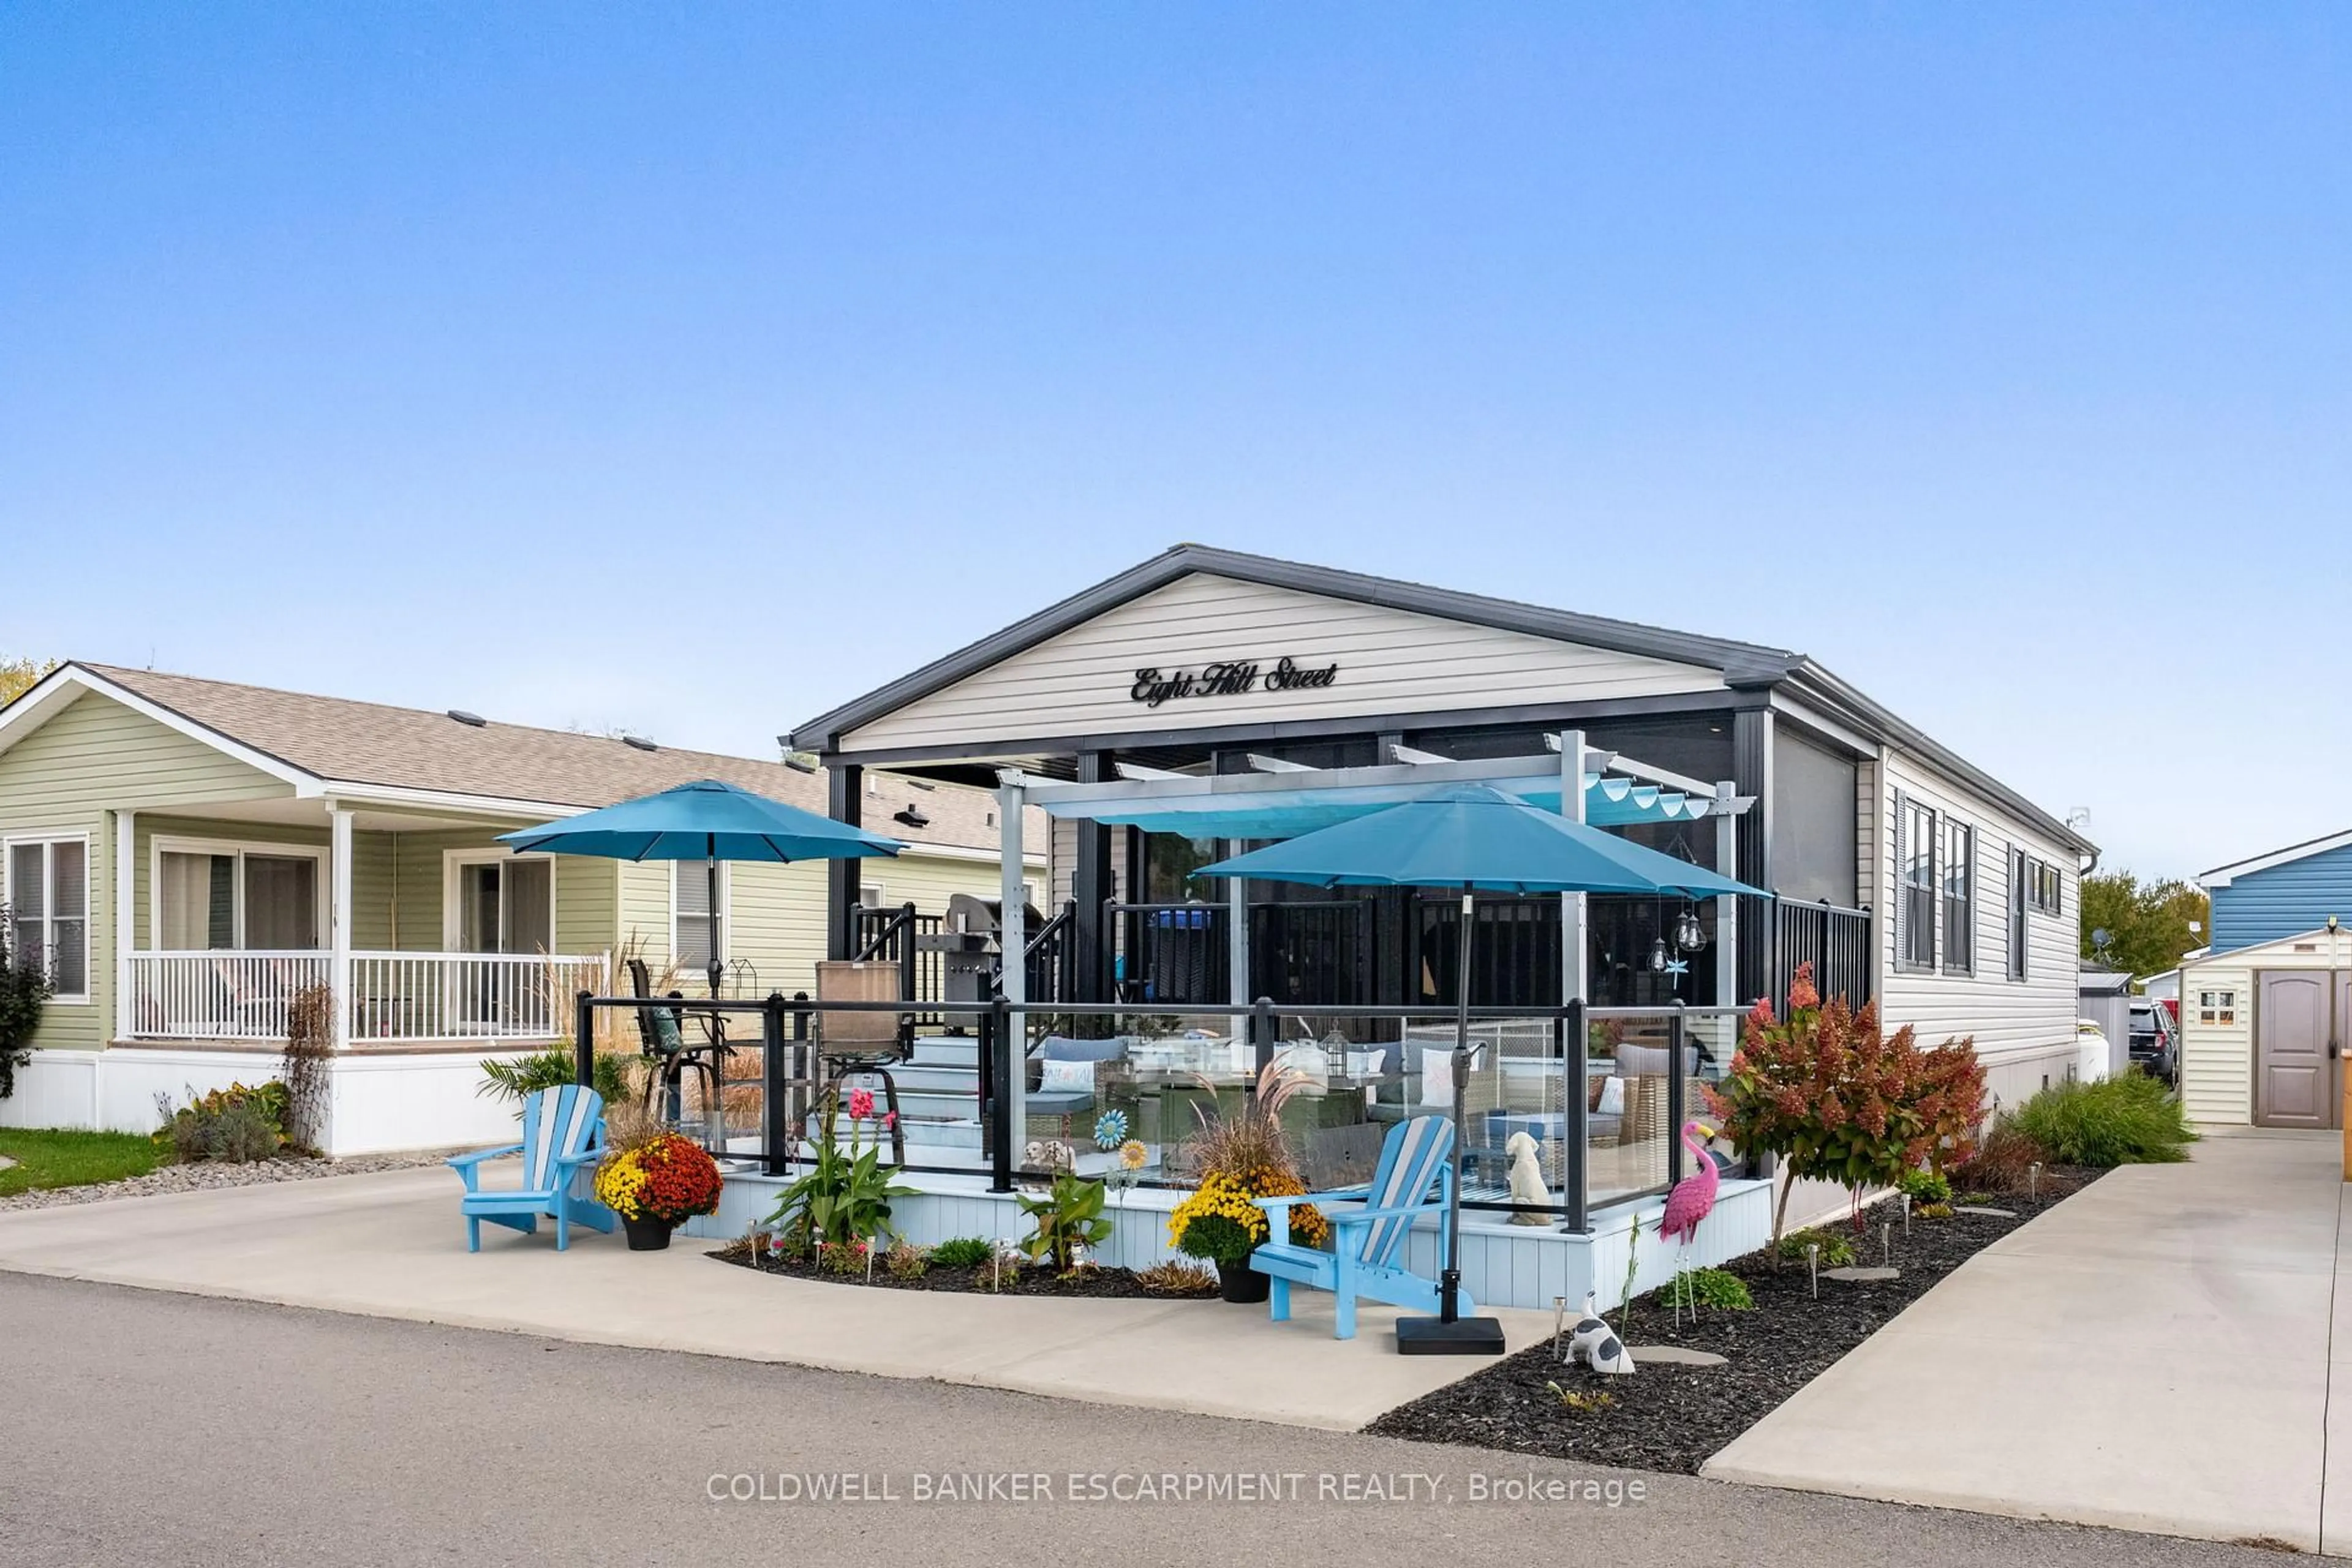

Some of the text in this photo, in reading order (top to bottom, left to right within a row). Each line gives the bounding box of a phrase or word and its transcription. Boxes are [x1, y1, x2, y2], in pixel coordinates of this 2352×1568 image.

[1131, 656, 1338, 707] Eight Hill Street
